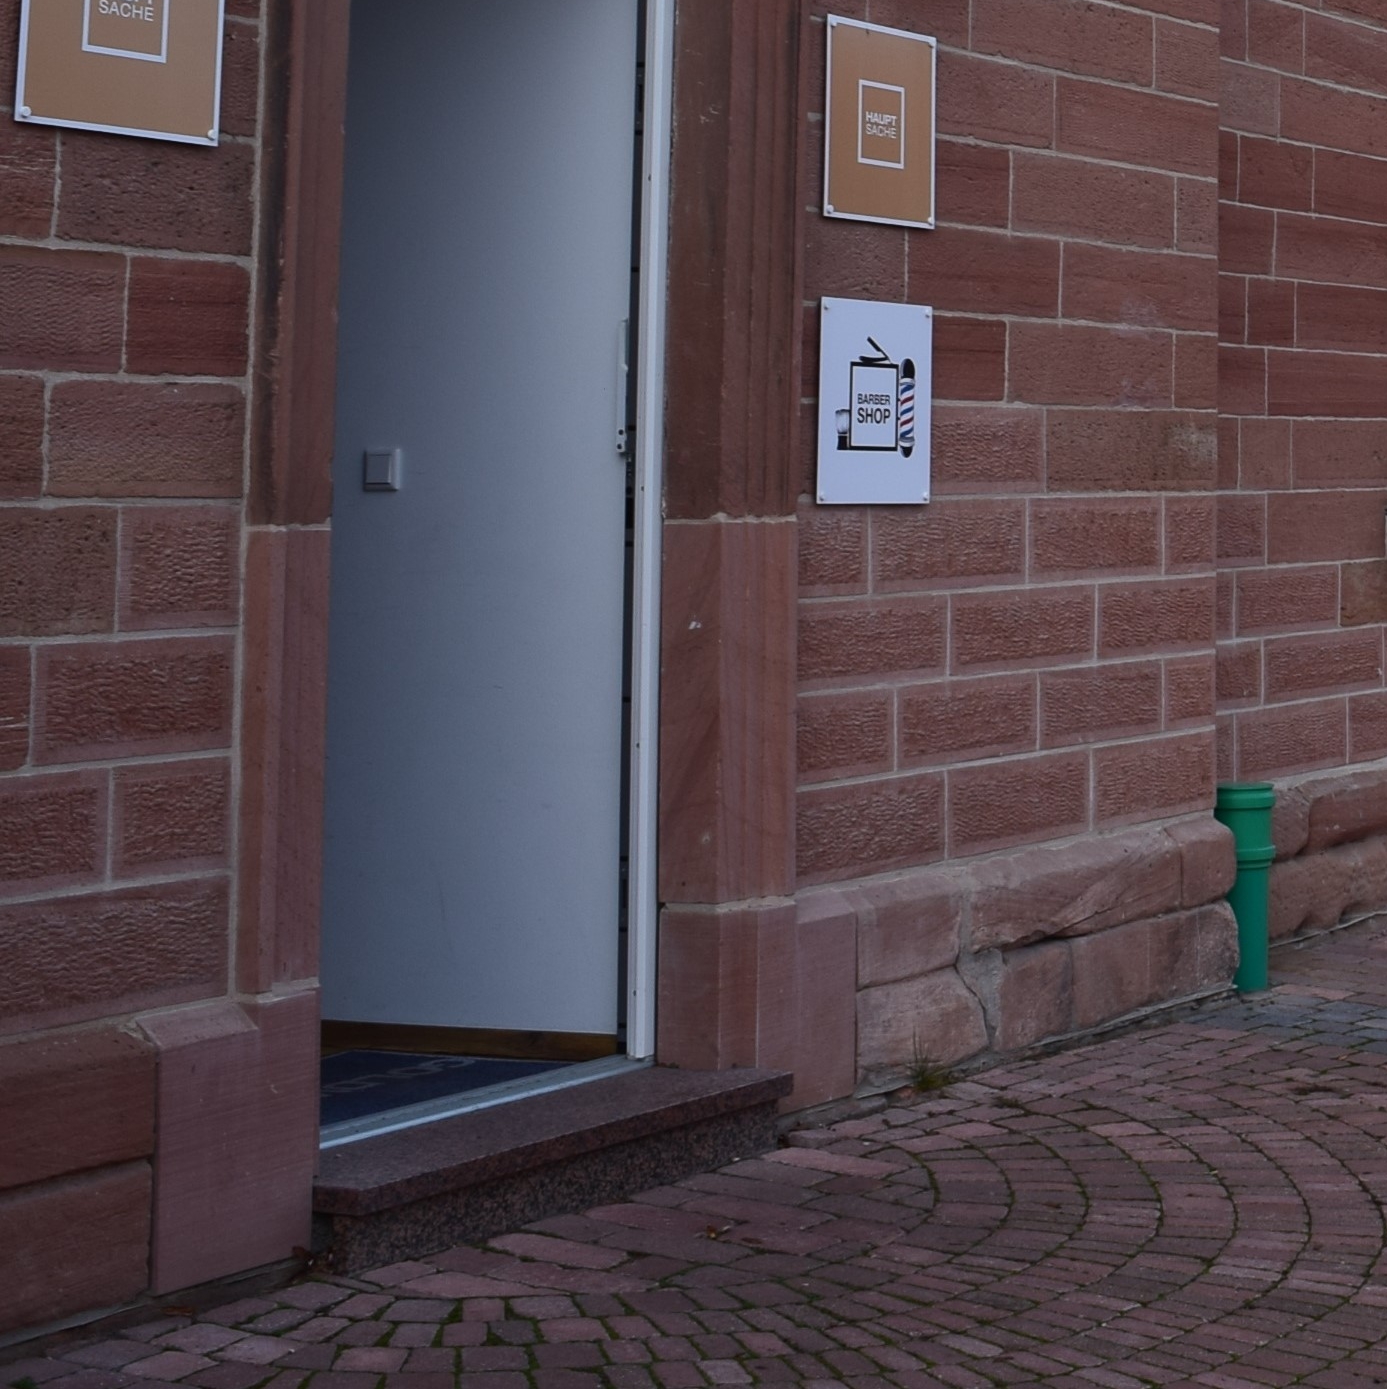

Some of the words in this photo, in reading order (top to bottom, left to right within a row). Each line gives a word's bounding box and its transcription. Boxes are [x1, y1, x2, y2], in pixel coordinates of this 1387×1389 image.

[865, 111, 897, 126] HAUPT
[865, 123, 897, 139] SACHE
[857, 393, 891, 405] BARBER
[857, 407, 891, 424] SHOP
